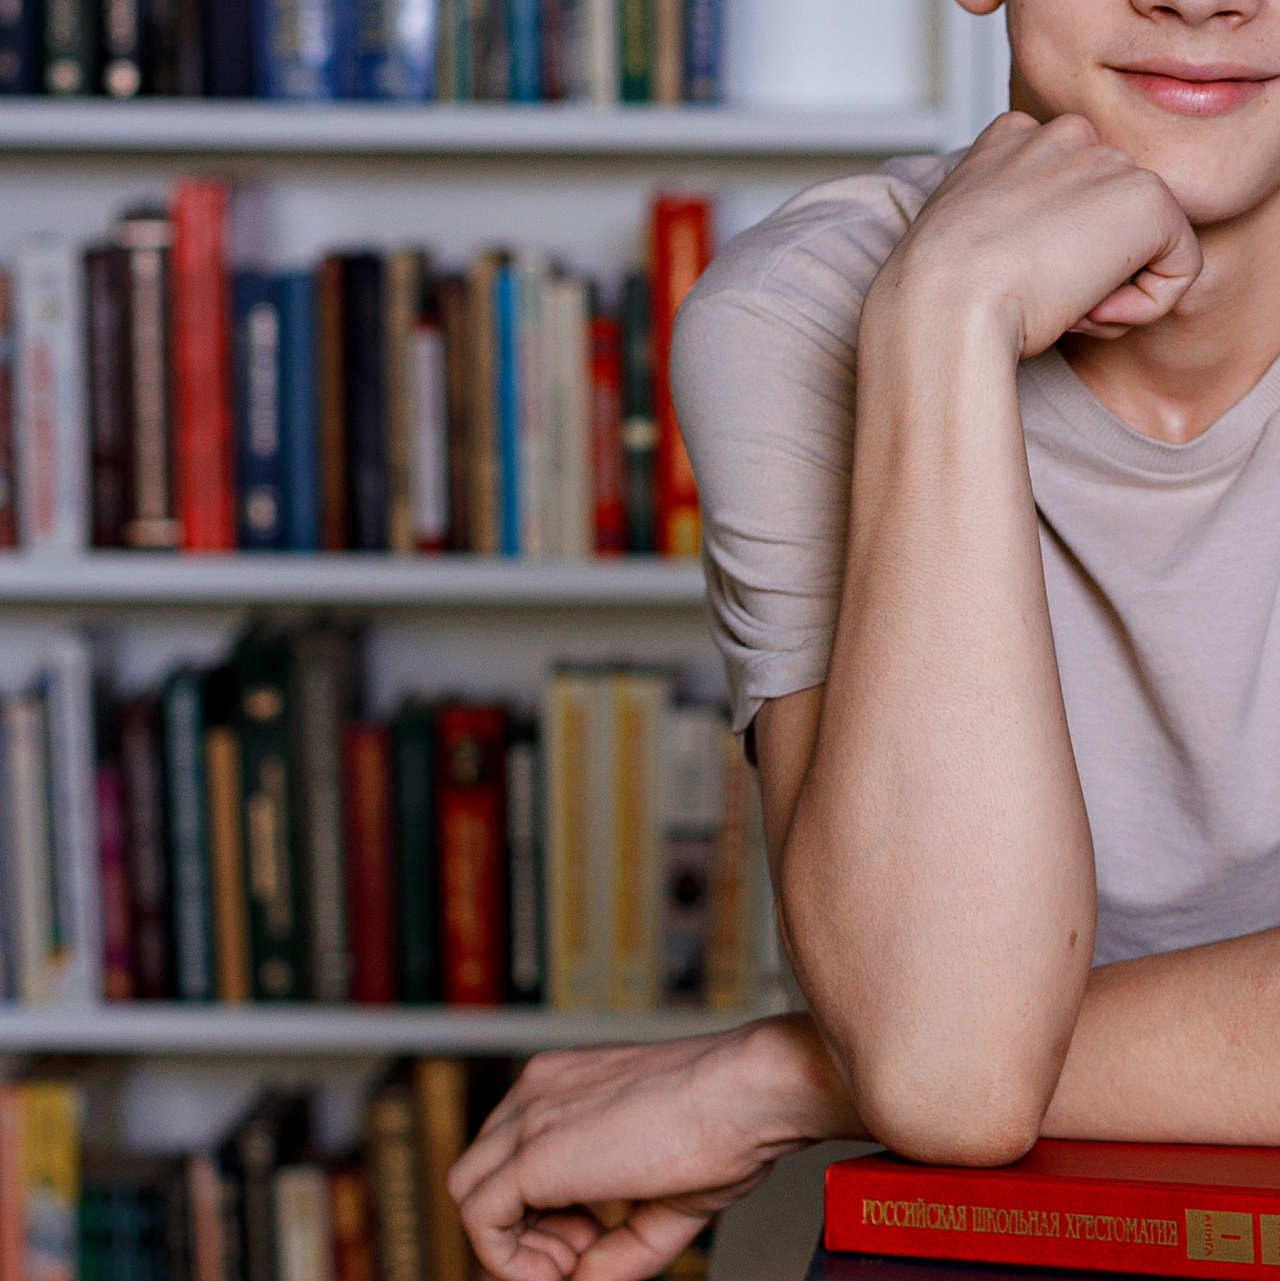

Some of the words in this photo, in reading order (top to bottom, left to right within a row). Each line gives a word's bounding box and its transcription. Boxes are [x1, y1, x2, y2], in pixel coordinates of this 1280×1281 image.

[861, 1198, 968, 1231] РОССИЙСКАЯ
[970, 1206, 1062, 1238] ШКОЛЬНАЯ
[1063, 1212, 1180, 1246] ХРЕСТОМАТИЯ
